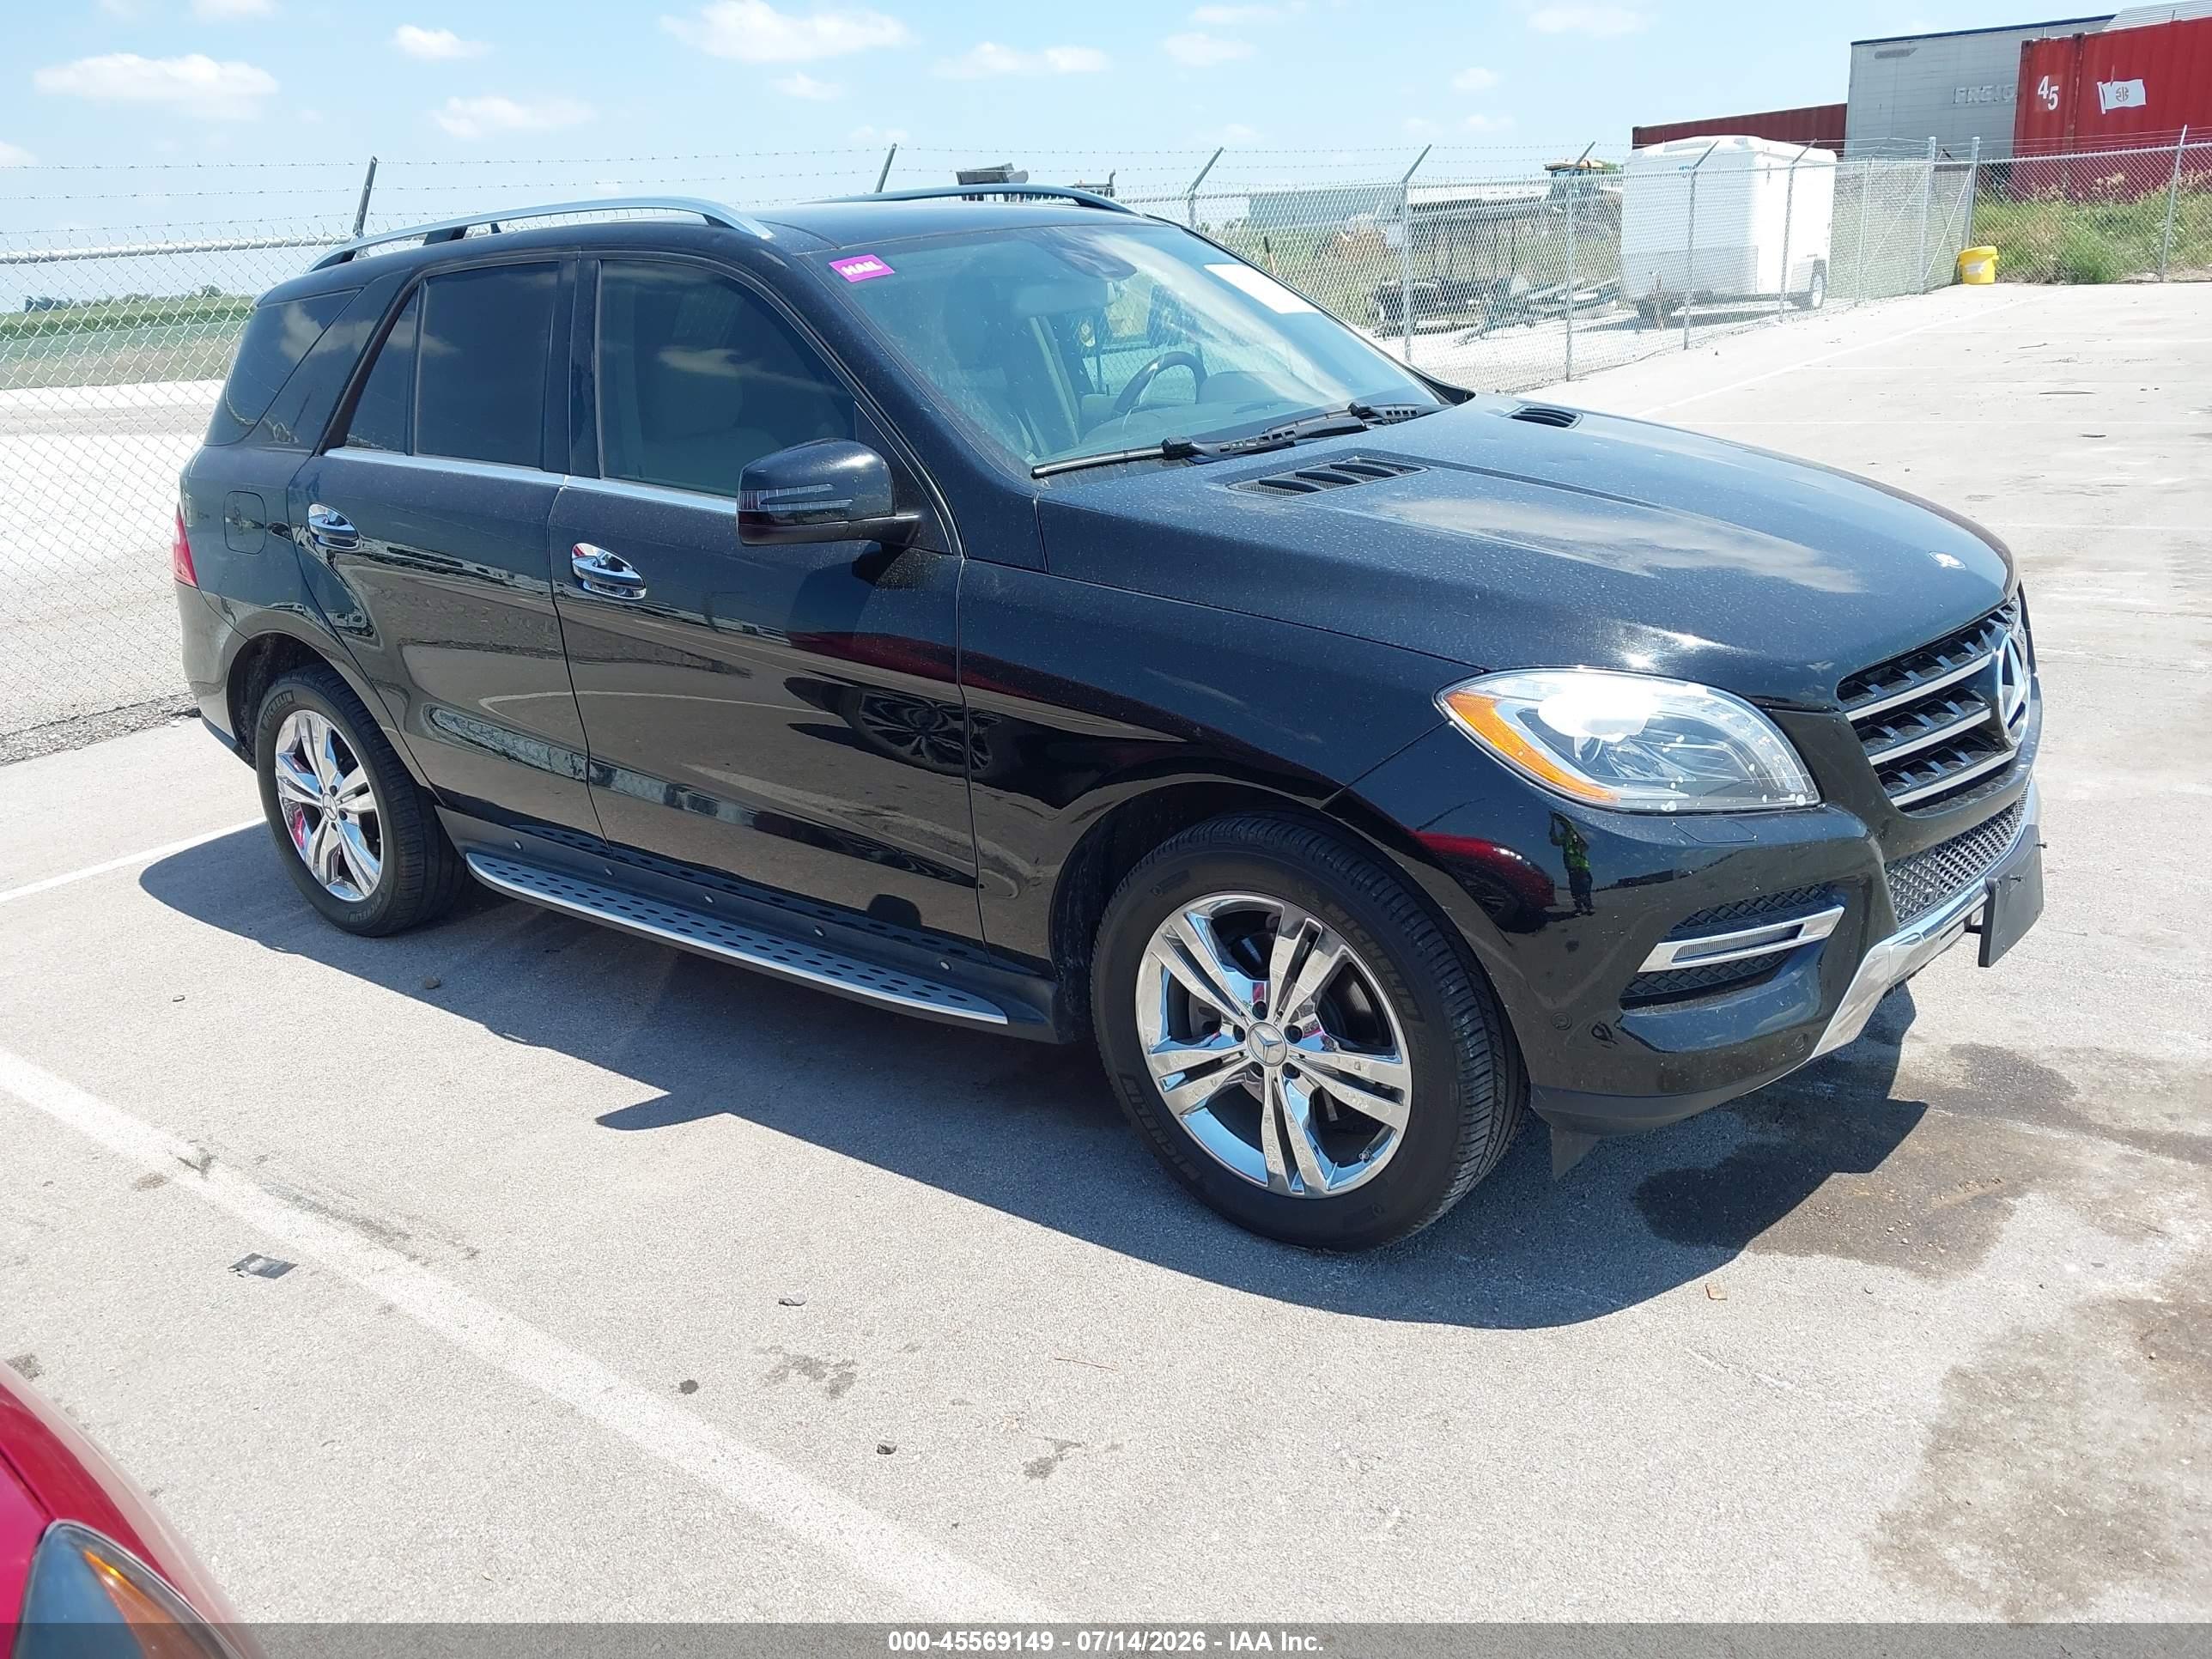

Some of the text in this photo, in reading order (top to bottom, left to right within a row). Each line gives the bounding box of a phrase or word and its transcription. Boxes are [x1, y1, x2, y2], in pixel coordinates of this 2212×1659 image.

[2038, 75, 2060, 111] 45
[841, 260, 884, 276] HAIL
[262, 691, 294, 728] MICHELIN
[1322, 902, 1420, 1018] MICHELIN
[1121, 1078, 1203, 1182] MICHELIN
